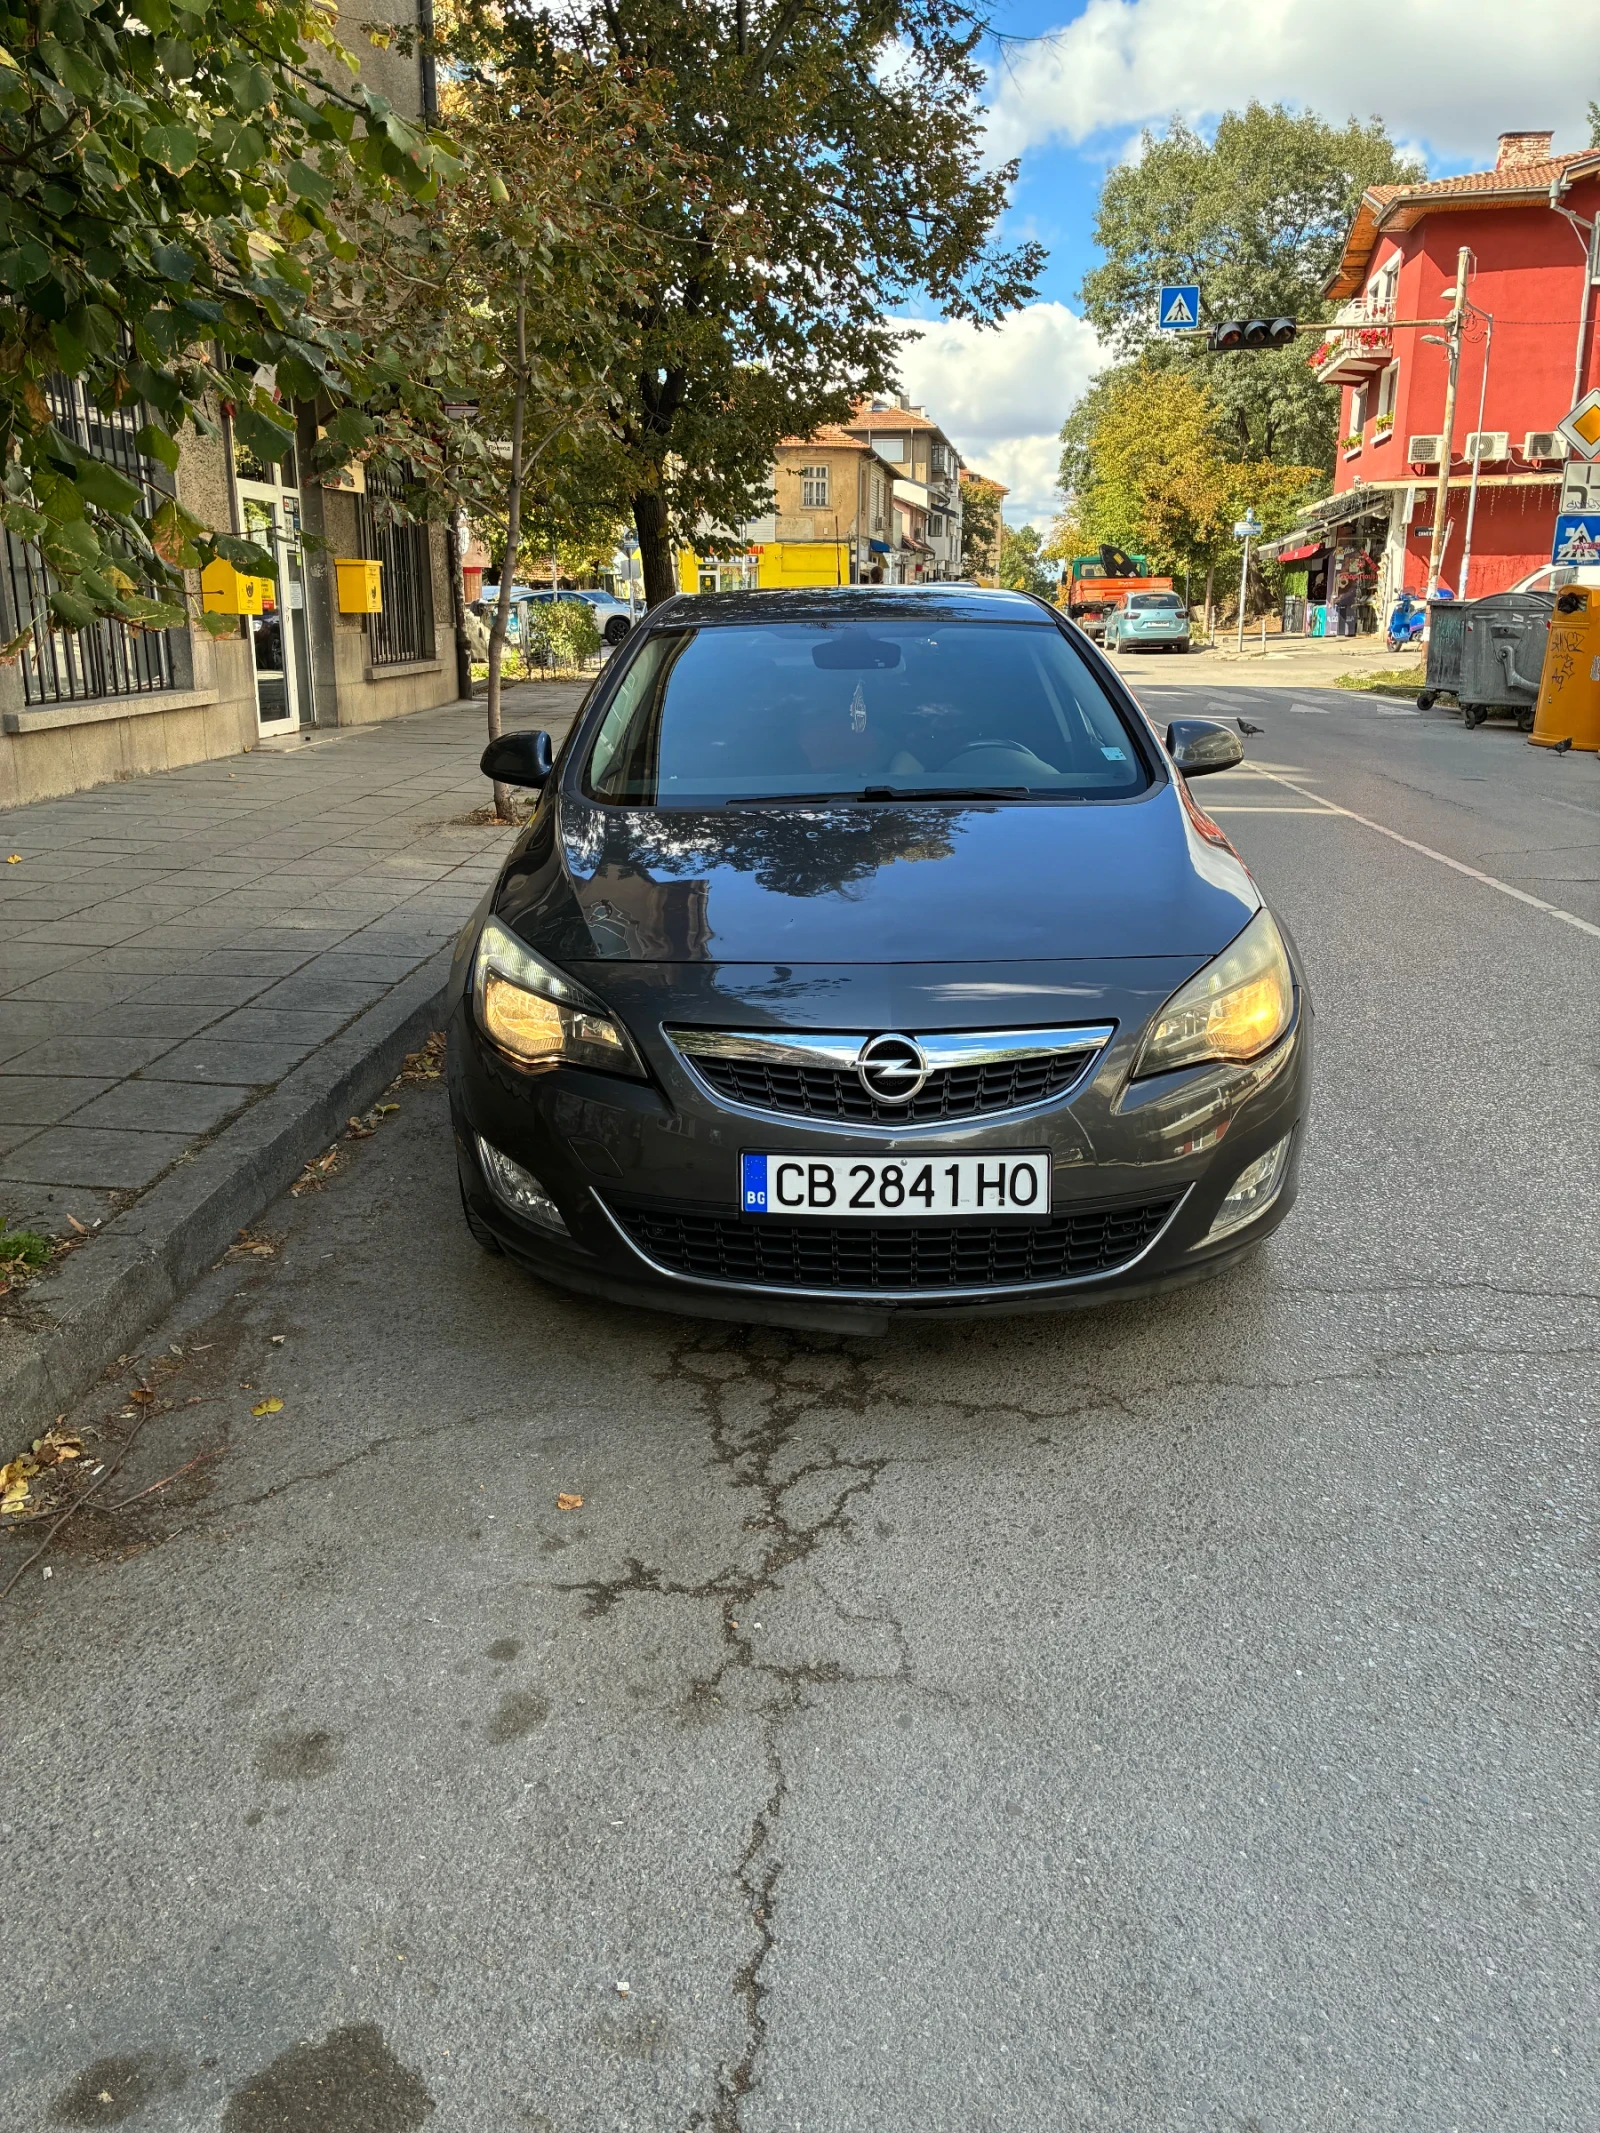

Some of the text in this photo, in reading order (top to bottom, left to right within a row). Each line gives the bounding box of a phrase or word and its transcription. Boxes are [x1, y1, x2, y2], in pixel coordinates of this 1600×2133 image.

[747, 1191, 765, 1205] BG
[776, 1163, 837, 1208] CB
[849, 1164, 960, 1208] 2841
